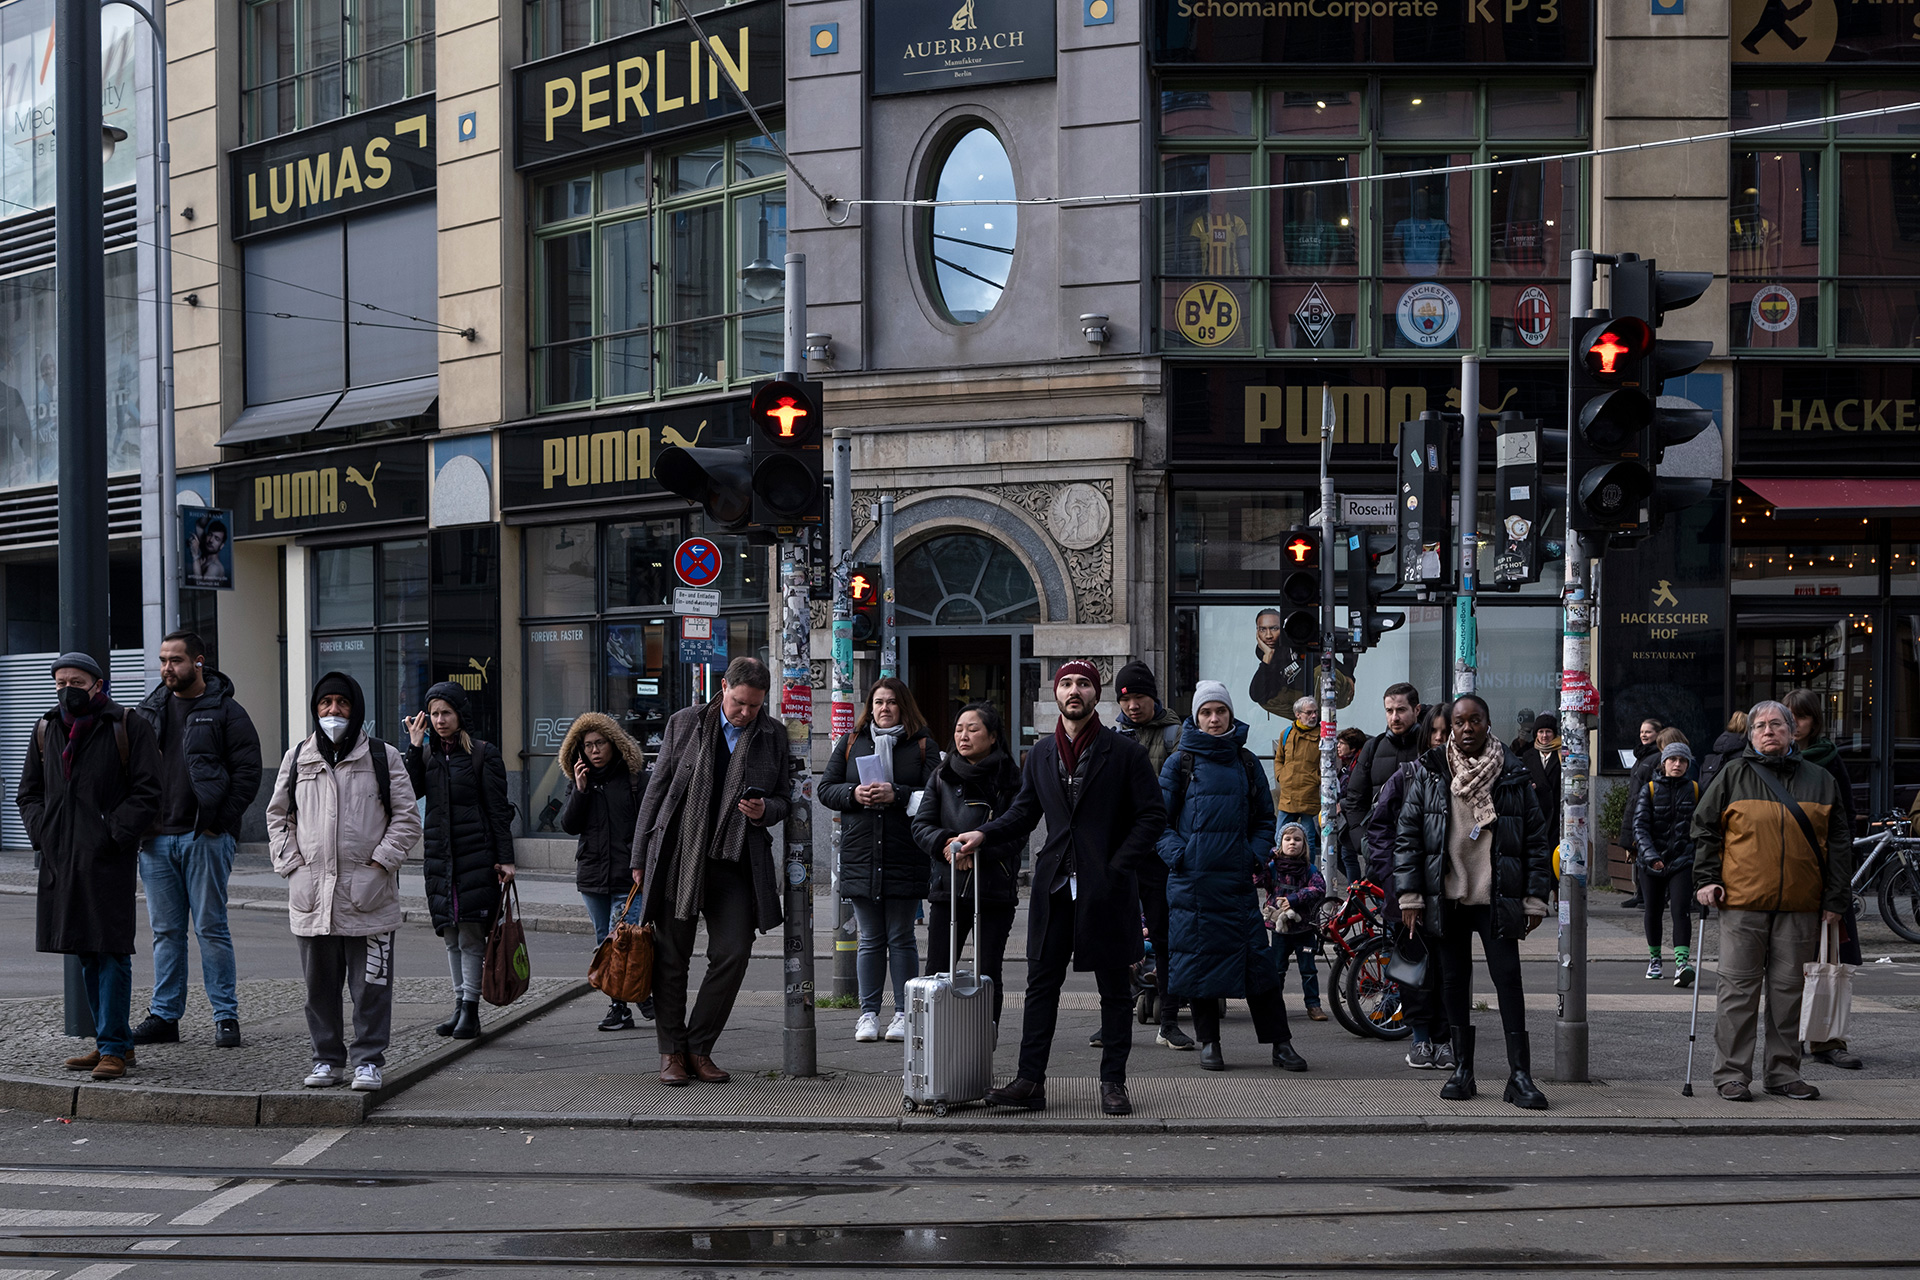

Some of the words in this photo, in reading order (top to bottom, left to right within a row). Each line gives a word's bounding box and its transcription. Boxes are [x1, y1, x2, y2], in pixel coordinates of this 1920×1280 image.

[1176, 0, 1438, 23] SchomannCorporate
[903, 31, 1024, 59] AUERBACH
[944, 57, 982, 67] Manufaktur
[545, 26, 749, 142] PERLIN
[248, 136, 392, 221] LUMAS
[1213, 231, 1226, 239] 1&1
[1403, 286, 1454, 308] MANCHESTER
[1523, 288, 1546, 300] ACM
[1185, 289, 1232, 327] BVB
[1198, 326, 1216, 339] 09
[1420, 335, 1439, 343] CITY
[1525, 333, 1545, 341] 1899
[1244, 386, 1427, 444] PUMA
[1772, 399, 1920, 432] HACKE
[543, 427, 651, 490] PUMA
[255, 467, 338, 522] PUMA
[688, 591, 696, 599] und
[697, 592, 716, 600] Entladen
[1620, 613, 1709, 624] HACKESCHER
[531, 631, 560, 642] FOREVER.
[1650, 628, 1679, 639] HOF
[320, 641, 344, 652] FOREVER.
[345, 639, 365, 650] FASTER.
[1632, 651, 1696, 660] RESTAURANT
